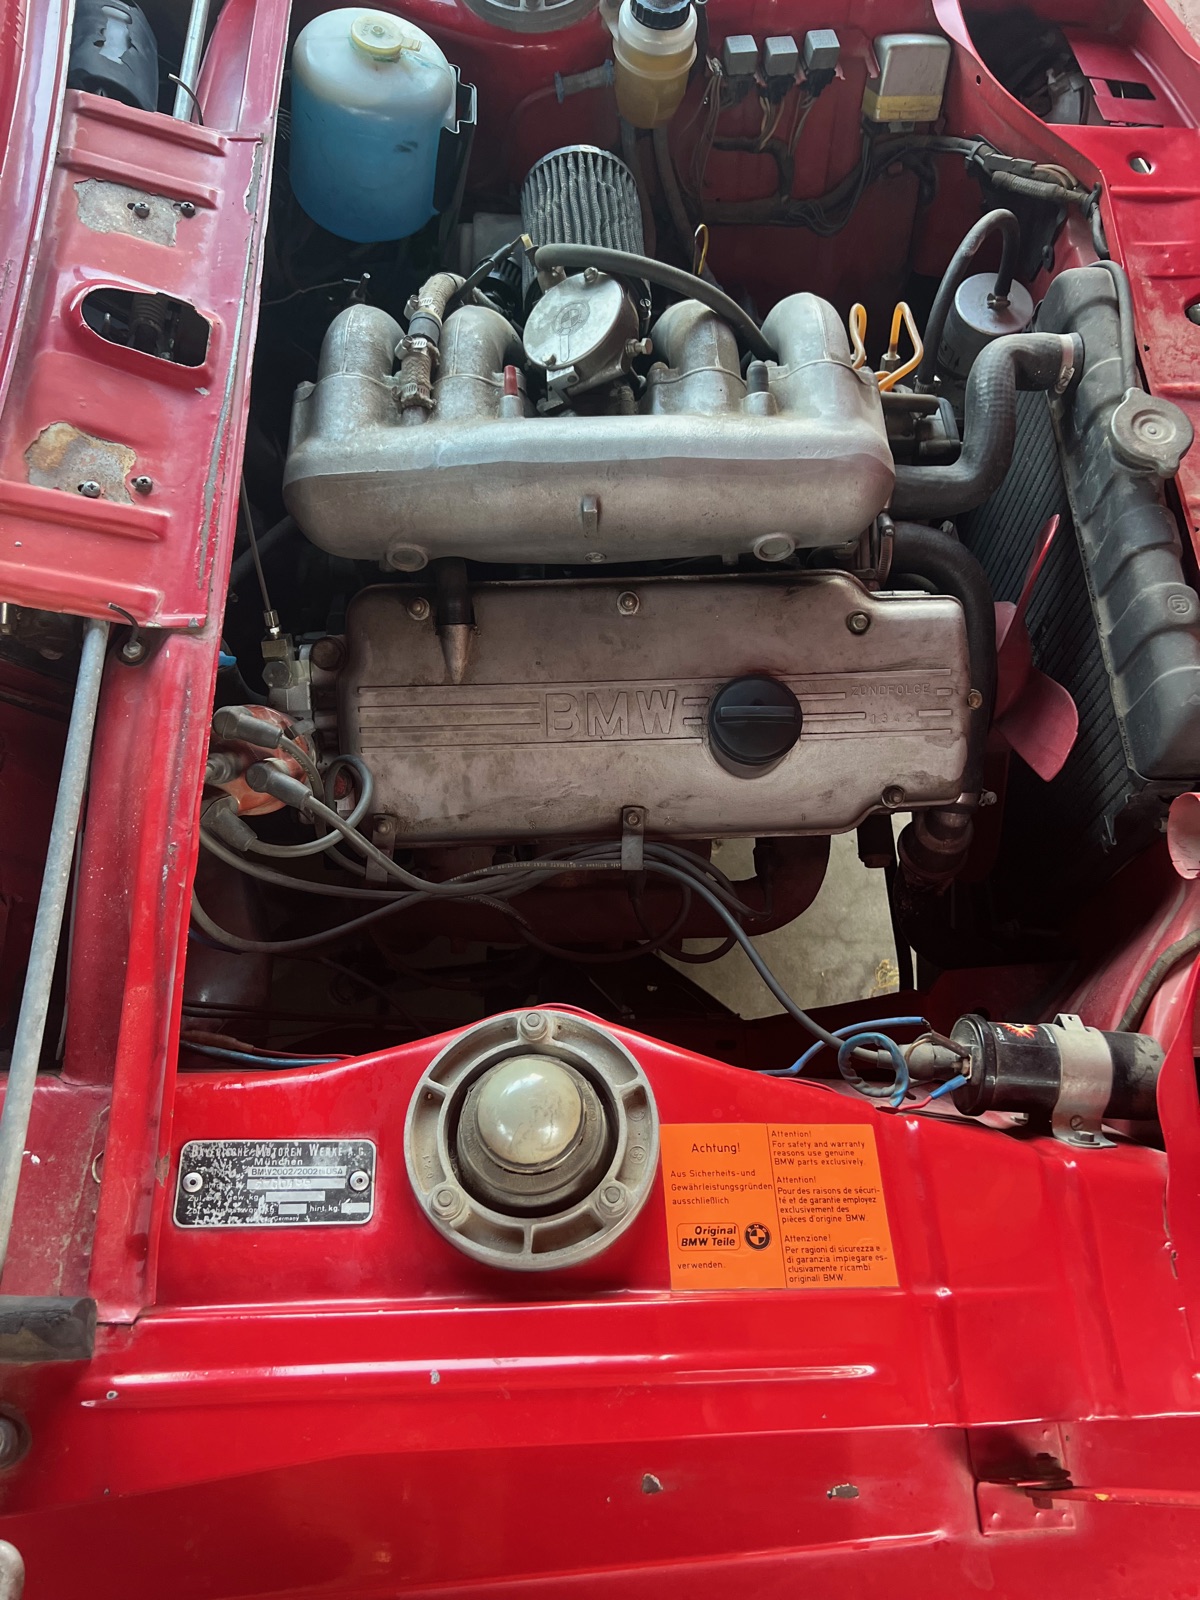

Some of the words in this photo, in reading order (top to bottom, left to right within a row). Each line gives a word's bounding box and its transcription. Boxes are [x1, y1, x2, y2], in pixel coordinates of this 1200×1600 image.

[546, 690, 677, 737] BMW
[771, 1130, 812, 1138] Attention!
[692, 1142, 741, 1155] Achtung!
[772, 1140, 786, 1148] For
[788, 1140, 811, 1149] safety
[814, 1140, 828, 1148] and
[830, 1140, 865, 1149] warranty
[309, 1143, 343, 1157] WERKE
[824, 1150, 855, 1158] genuine
[254, 1158, 303, 1166] München
[774, 1158, 795, 1166] BMW
[798, 1159, 818, 1168] parts
[821, 1158, 865, 1167] exclusively.
[670, 1170, 686, 1178] Aus
[776, 1176, 817, 1184] Attention!
[671, 1182, 773, 1192] Gewährleistungsgründen
[812, 1186, 841, 1194] raisons
[843, 1186, 852, 1194] de
[854, 1186, 880, 1194] sécuri-
[778, 1196, 786, 1204] té
[788, 1196, 796, 1204] et
[798, 1196, 808, 1204] de
[810, 1196, 841, 1205] garantie
[842, 1196, 876, 1204] employez
[782, 1216, 806, 1224] pièces
[808, 1214, 842, 1224] d'origine
[694, 1226, 737, 1237] Original
[681, 1238, 708, 1247] BMW
[712, 1238, 736, 1246] Teile
[784, 1234, 831, 1242] Attenzione!
[786, 1246, 799, 1254] Per
[801, 1246, 828, 1256] ragioni
[830, 1245, 836, 1253] di
[786, 1256, 794, 1264] di
[796, 1256, 831, 1266] garanzia
[833, 1255, 873, 1264] impiegare
[677, 1262, 726, 1270] verwenden.
[788, 1265, 838, 1273] clusivamente
[840, 1264, 871, 1272] ricambi
[788, 1275, 820, 1285] originali
